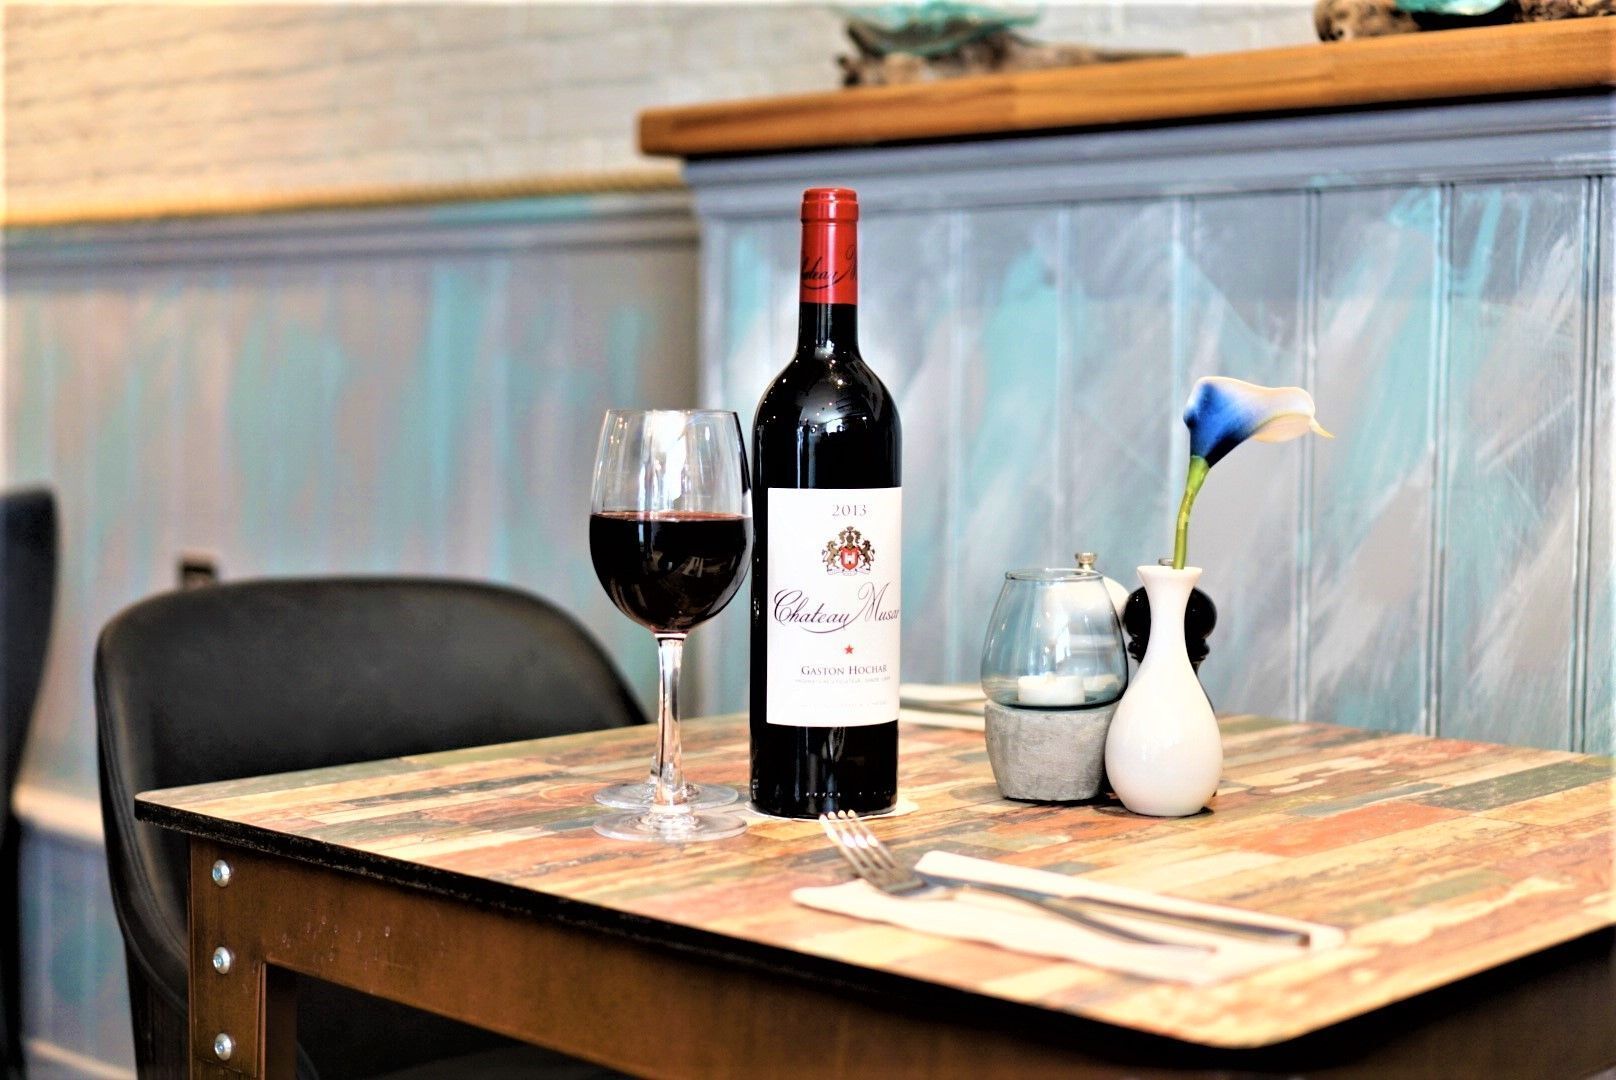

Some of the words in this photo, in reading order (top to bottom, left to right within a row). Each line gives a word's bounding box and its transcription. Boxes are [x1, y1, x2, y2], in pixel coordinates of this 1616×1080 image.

[832, 504, 867, 517] 2013
[773, 588, 851, 631] Chateau
[857, 581, 900, 622] Musar
[801, 665, 844, 676] GASTON
[848, 664, 888, 675] HOCHAR
